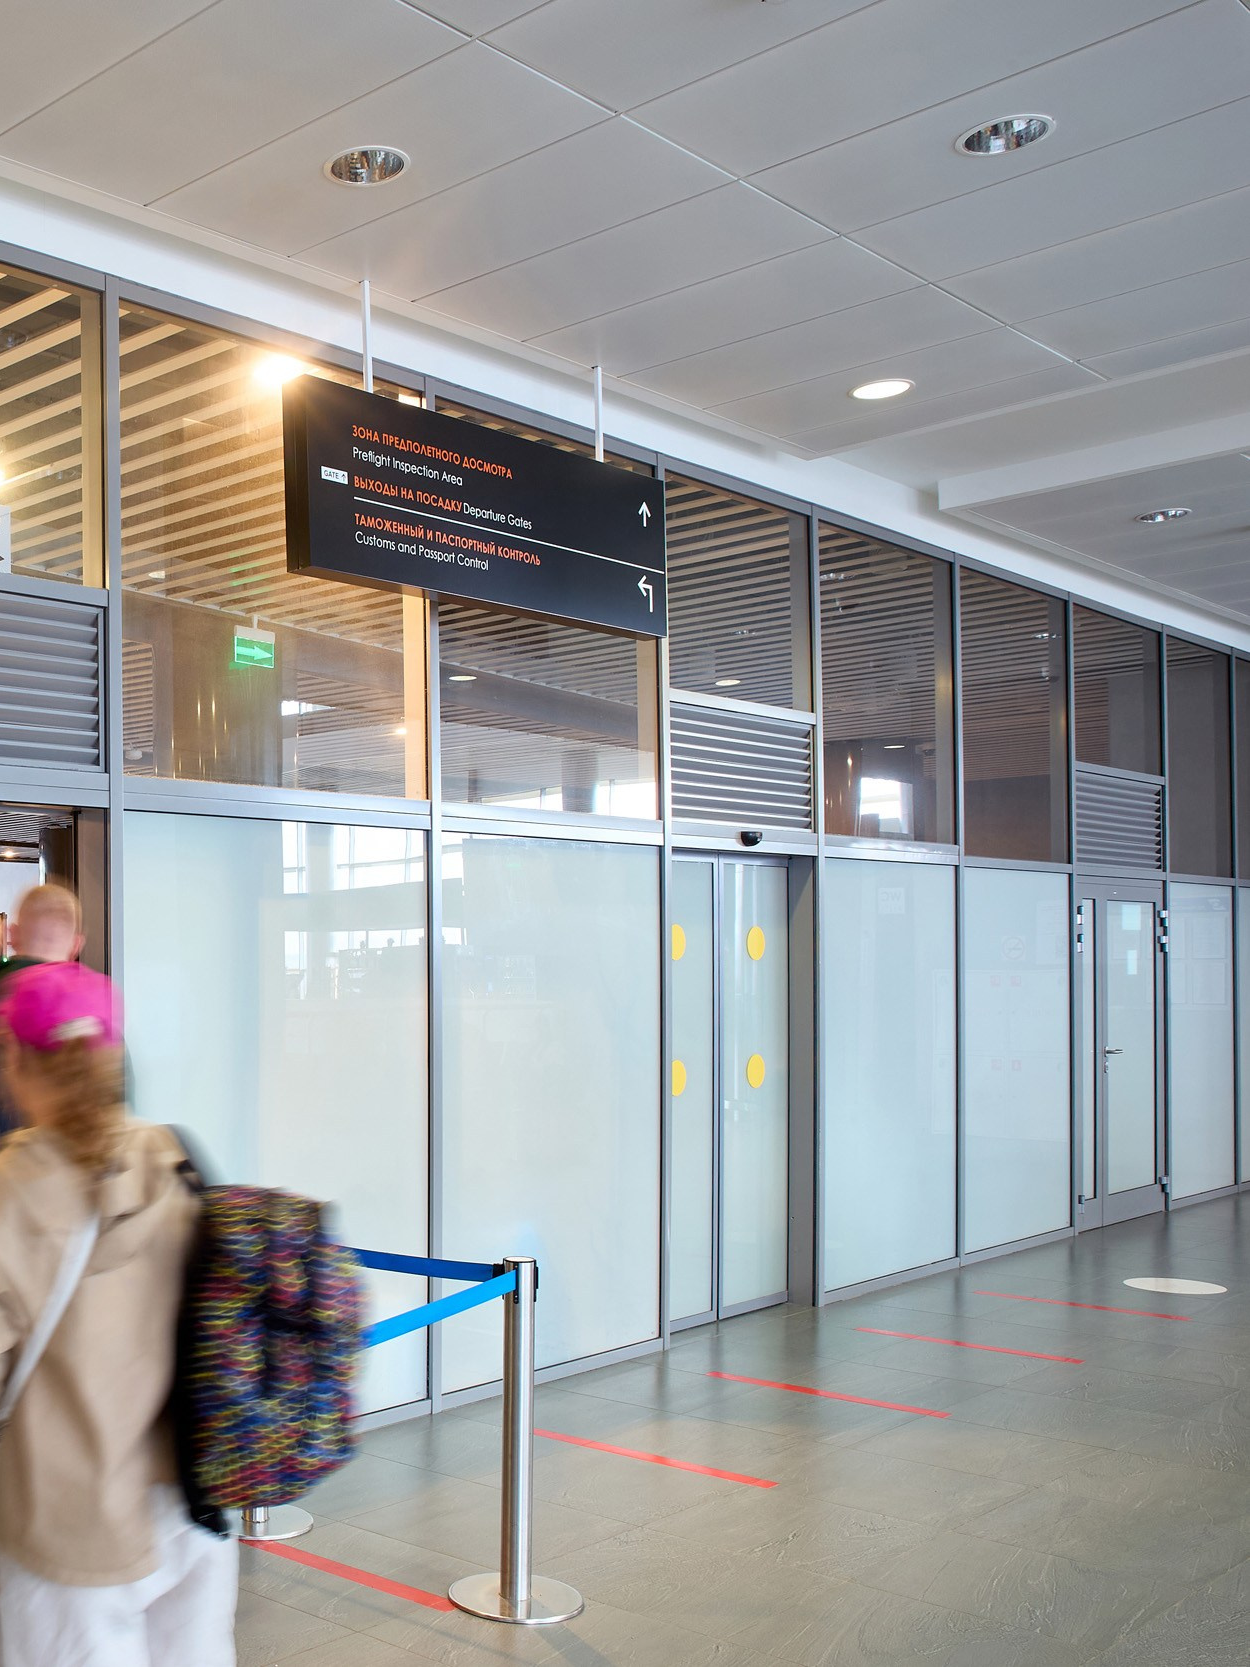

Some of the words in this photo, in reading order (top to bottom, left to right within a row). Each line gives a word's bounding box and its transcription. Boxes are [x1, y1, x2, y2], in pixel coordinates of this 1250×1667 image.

[323, 469, 339, 480] GATE
[352, 424, 380, 443] ЗОНА
[382, 433, 461, 465] ПРЕДПОЛЕТНОГО
[462, 456, 513, 480] ДОСМОТРА
[352, 446, 391, 468] Preflight
[393, 457, 440, 481] Inspection
[442, 471, 463, 486] Area
[354, 475, 398, 497] ВЫХОДЫ
[401, 487, 414, 501] НА
[416, 490, 462, 512] ПОСАДКУ
[463, 502, 506, 519] Departure
[507, 513, 532, 530] Gates
[354, 513, 424, 540] ТАМОЖЕННЫЙ
[426, 529, 433, 541] И
[436, 531, 496, 555] ПАСПОРТНЫЙ
[497, 545, 541, 566] КОНТРОЛЬ
[355, 531, 396, 551] Customs
[397, 542, 416, 556] and
[418, 545, 455, 563] Passport
[457, 553, 489, 571] Control
